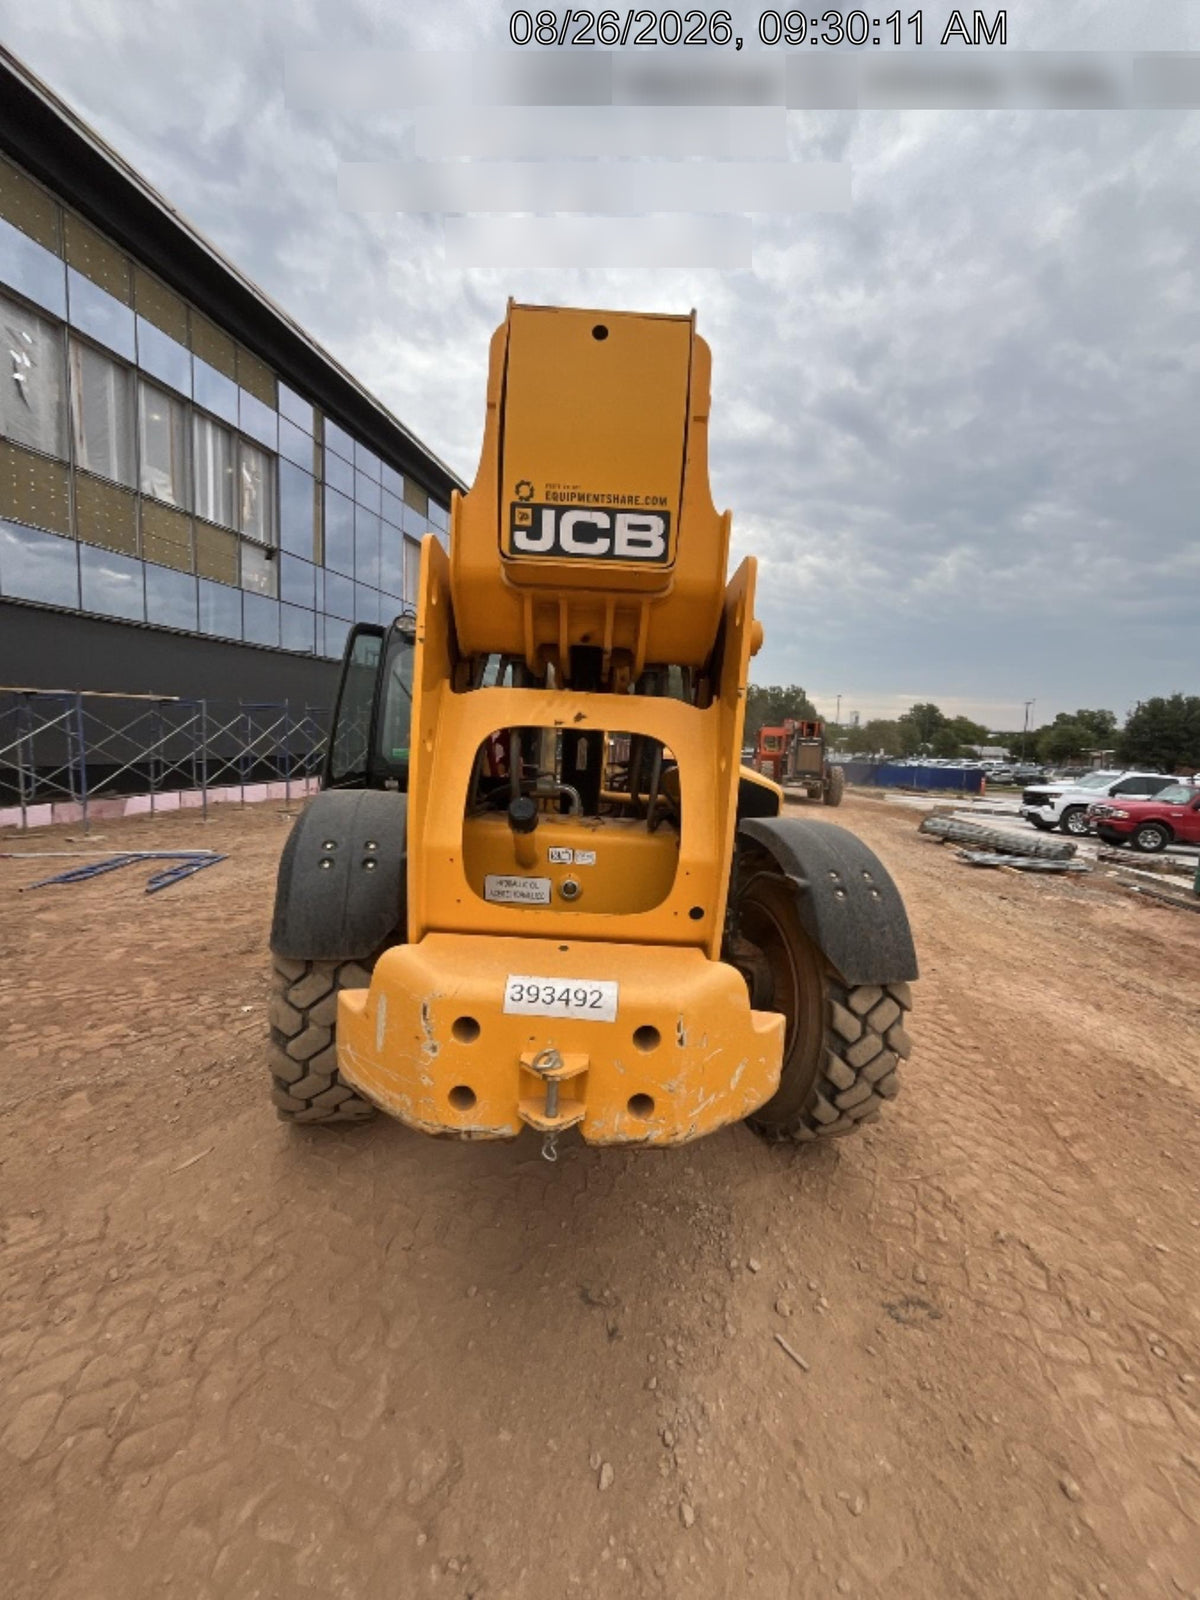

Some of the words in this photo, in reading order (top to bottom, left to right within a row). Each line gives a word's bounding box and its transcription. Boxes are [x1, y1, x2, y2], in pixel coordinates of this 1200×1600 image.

[545, 490, 668, 507] EQUIPMENTSHARE.COM
[513, 508, 666, 557] JCB
[510, 984, 604, 1009] 393492
